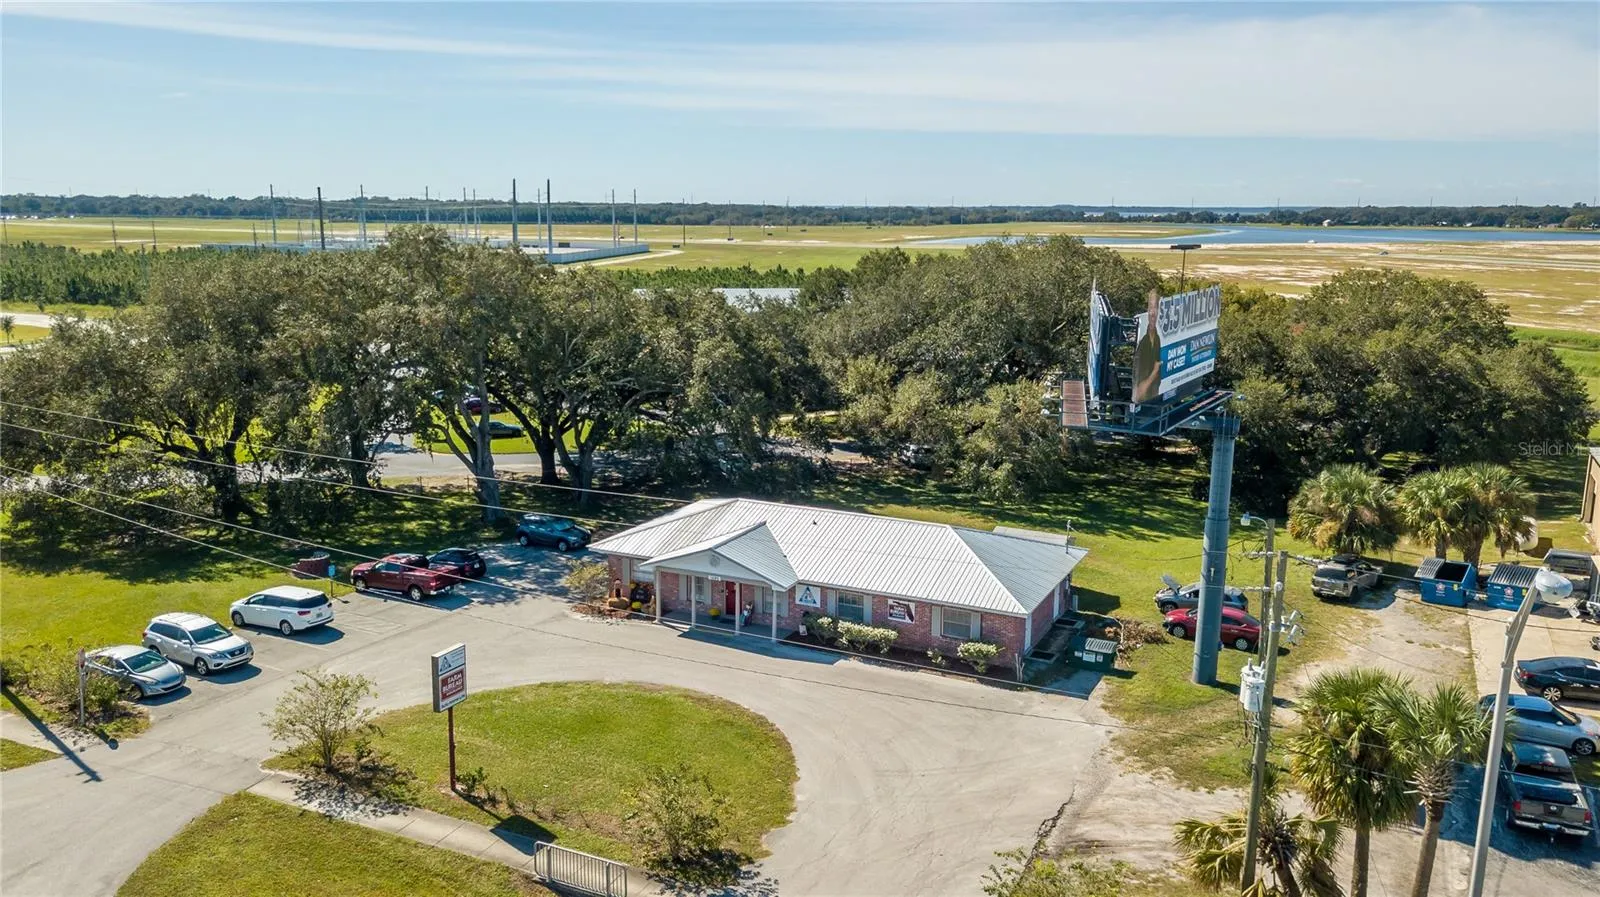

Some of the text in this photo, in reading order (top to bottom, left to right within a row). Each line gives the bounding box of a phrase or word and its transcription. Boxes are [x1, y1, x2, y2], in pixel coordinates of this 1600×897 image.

[1182, 287, 1220, 326] MILLION
[442, 678, 463, 692] BUREAU
[448, 673, 463, 684] FARM
